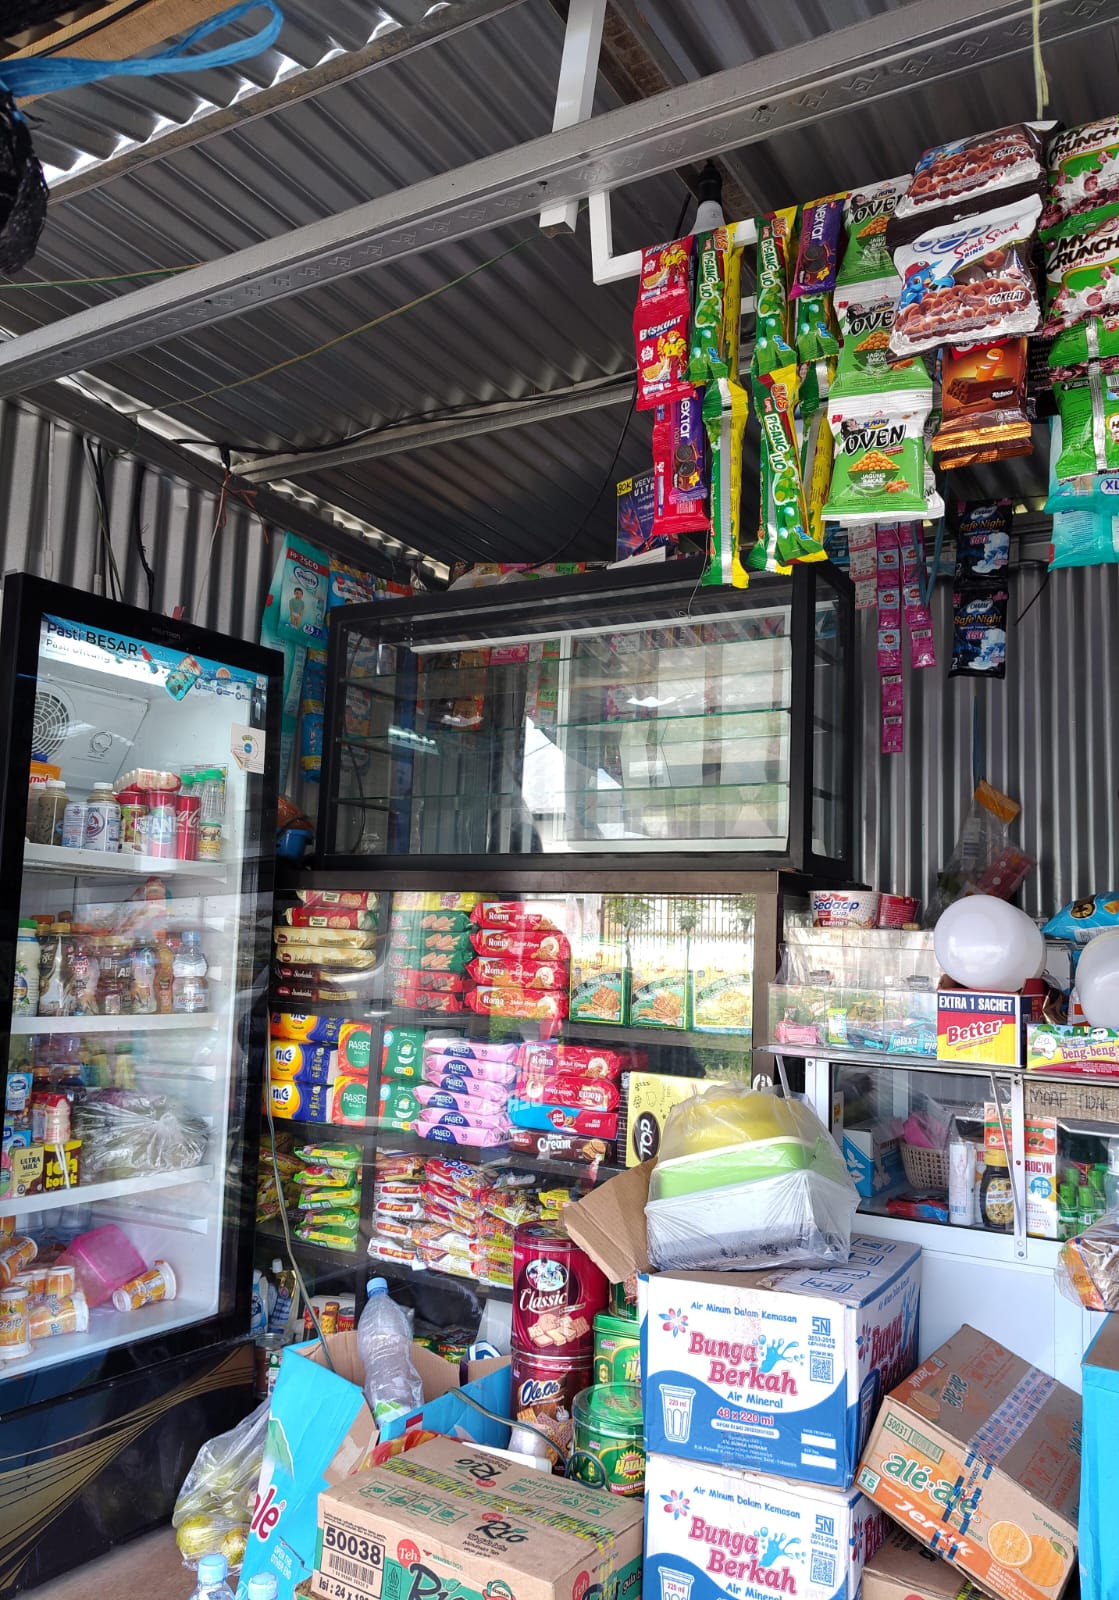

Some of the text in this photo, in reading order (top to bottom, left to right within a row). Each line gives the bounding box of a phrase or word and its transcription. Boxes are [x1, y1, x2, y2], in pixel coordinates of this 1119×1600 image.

[953, 237, 985, 259] Snack
[964, 246, 984, 258] RING
[1046, 235, 1119, 274] CRUNCH
[1058, 234, 1090, 253] MY
[703, 251, 718, 283] PISANG
[762, 239, 778, 272] PISANG
[989, 291, 1025, 305] COKELAT
[850, 310, 897, 337] OVE
[764, 413, 787, 457] PISANG
[844, 424, 905, 455] OVEN
[980, 519, 1006, 530] Night
[953, 614, 1002, 626] Safe Night
[47, 622, 81, 642] Pasti
[85, 630, 138, 656] BESAR
[939, 995, 1013, 1012] EXTRA 1 SACHET
[946, 1019, 1002, 1045] Better
[532, 1054, 554, 1066] Roma
[1061, 1046, 1116, 1060] beng-beng
[537, 1138, 571, 1152] Cream
[640, 1119, 653, 1156] TOP
[520, 1288, 567, 1312] Classic
[691, 1301, 797, 1323] Air Minum Dalam Kemasan
[688, 1331, 757, 1366] Bunga
[708, 1360, 798, 1395] Berkah
[727, 1391, 784, 1409] Air Mineral
[717, 1407, 730, 1418] 48
[740, 1410, 759, 1423] 220
[761, 1416, 774, 1426] ml
[887, 1418, 908, 1437] 50031
[861, 1473, 876, 1489] 15
[252, 1488, 279, 1539] le
[693, 1486, 801, 1519] Air Minum Dalam Kemasan
[474, 1520, 530, 1543] Rio
[688, 1515, 759, 1557] Bunga
[325, 1526, 381, 1566] 50038
[399, 1547, 420, 1561] Teh
[706, 1547, 798, 1596] Berkah
[319, 1577, 329, 1592] Isi
[335, 1585, 345, 1599] 24
